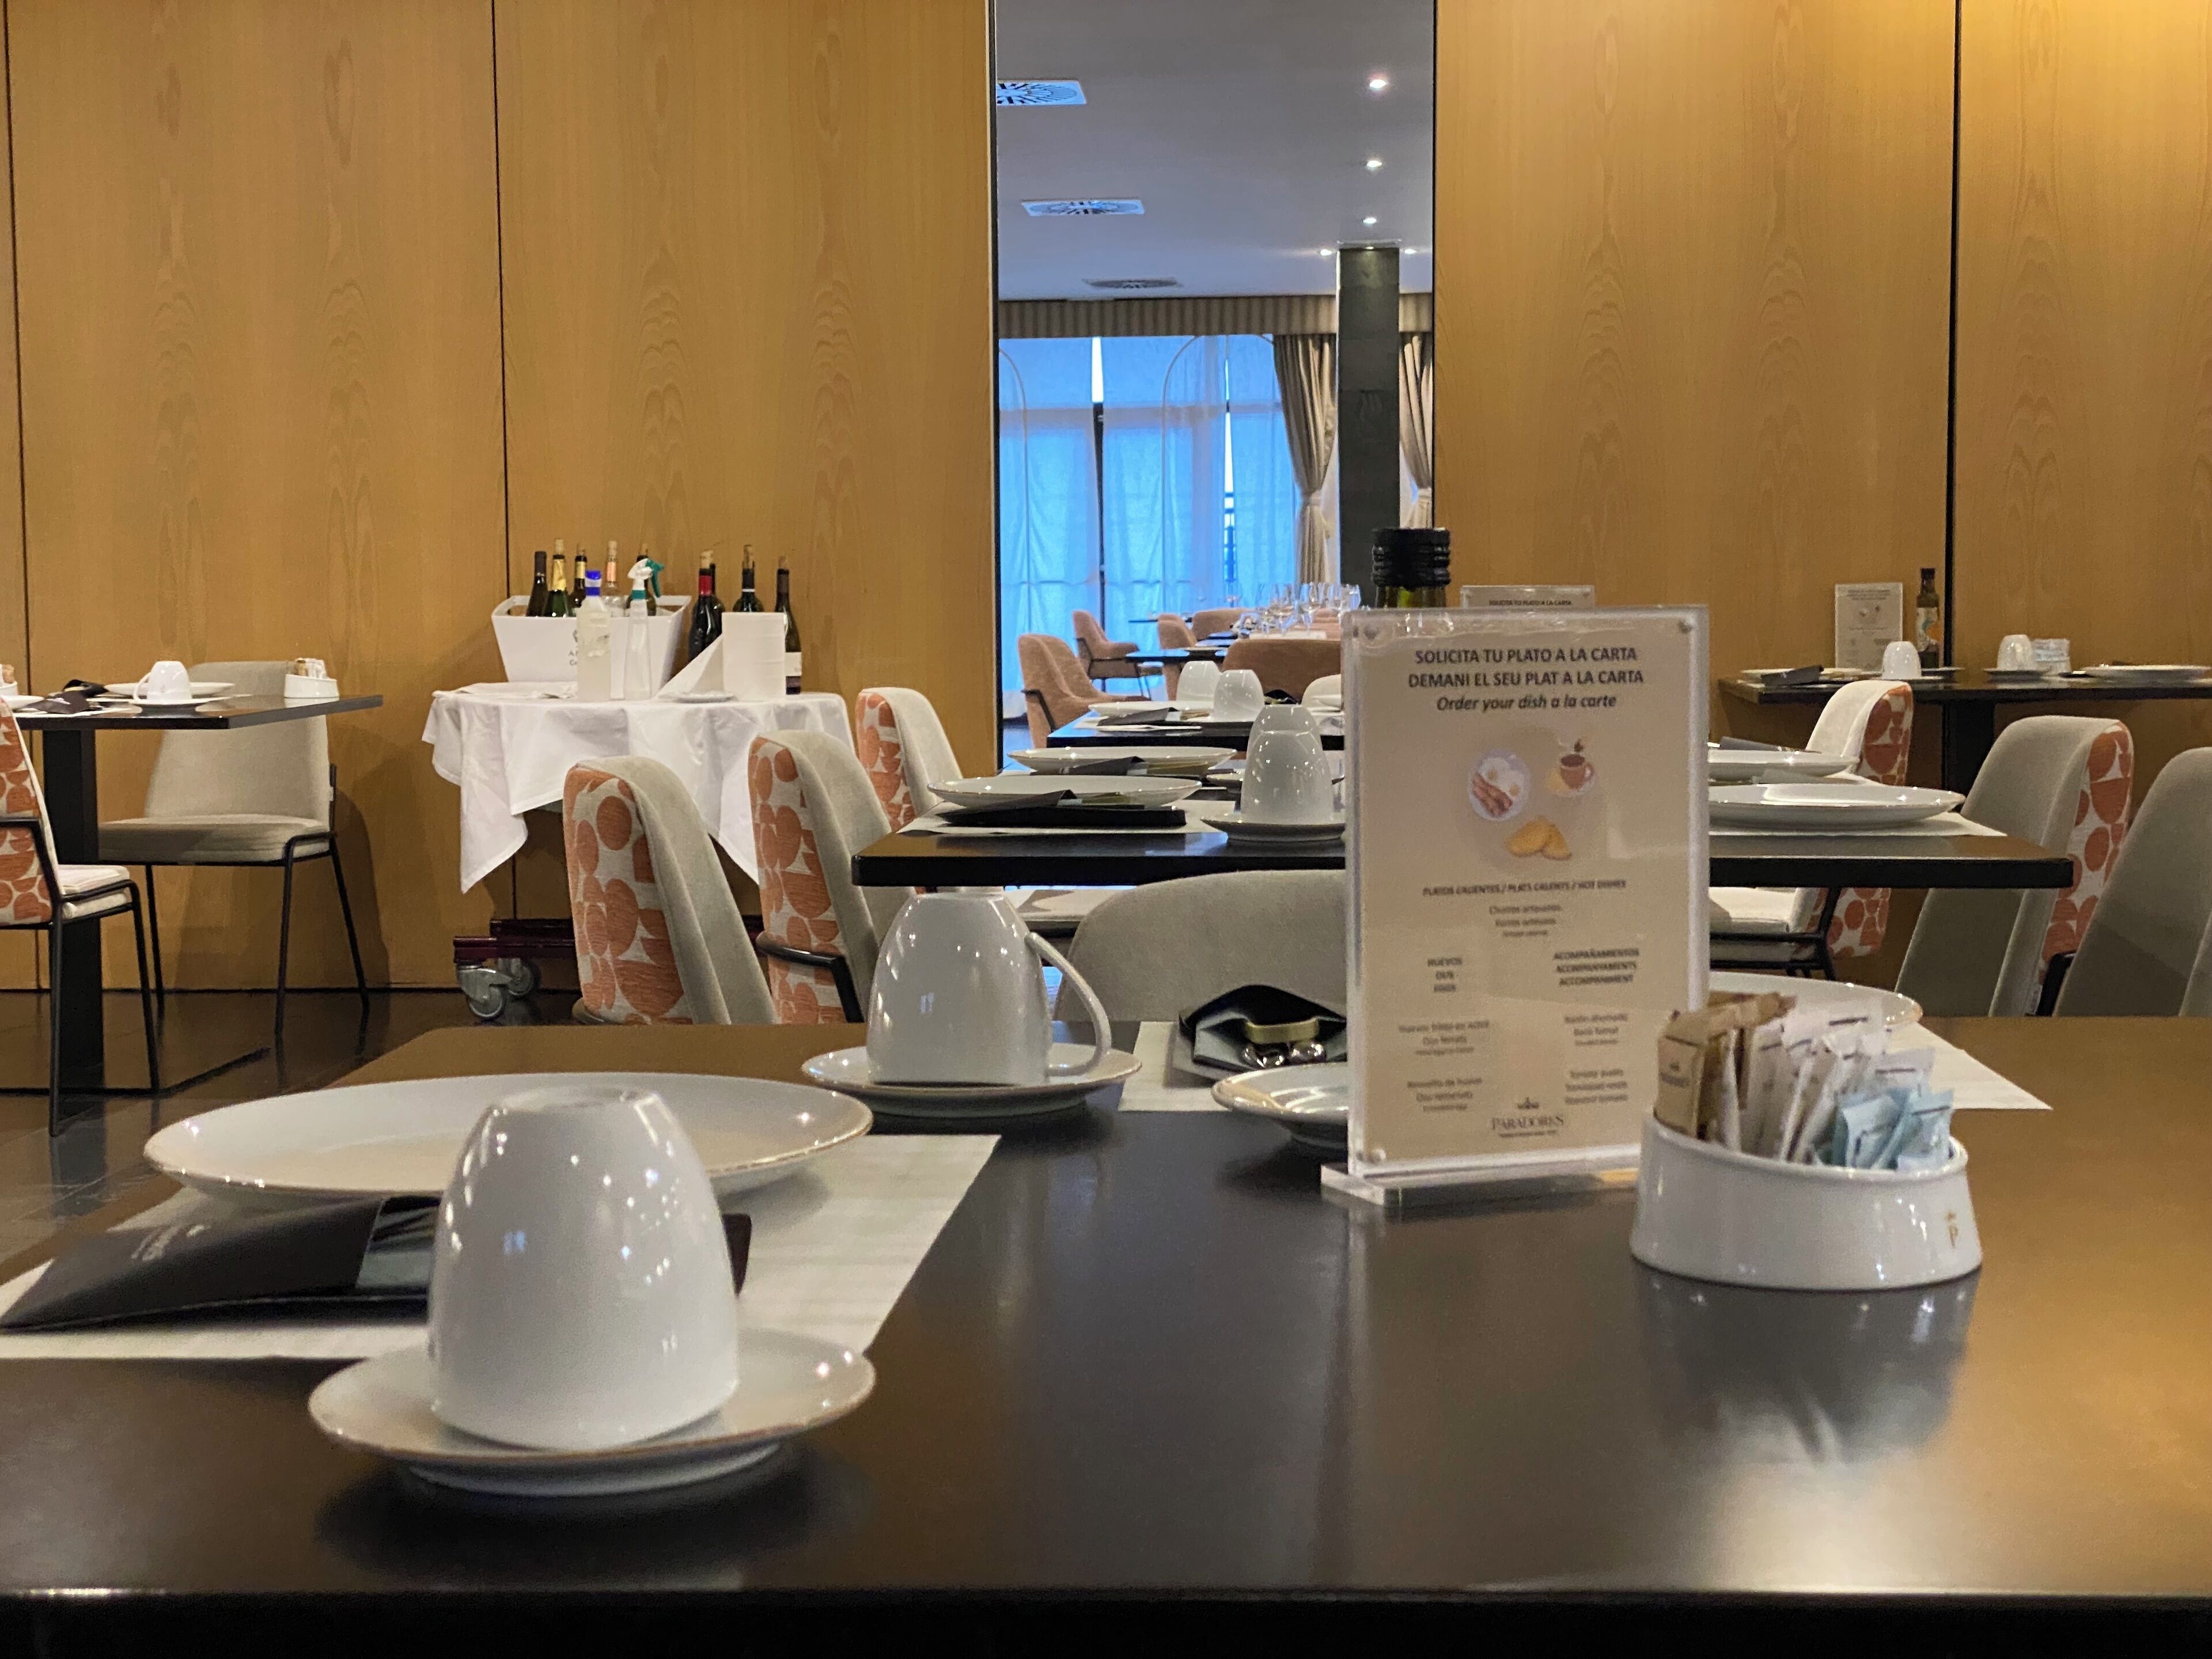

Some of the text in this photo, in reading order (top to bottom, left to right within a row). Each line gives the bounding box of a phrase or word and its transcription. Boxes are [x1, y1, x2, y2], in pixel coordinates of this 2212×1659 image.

[1415, 647, 1637, 664] SOLICITA TU PLATO A LA CARTA
[1408, 670, 1643, 687] DEMANI EL SEU PLAT A LA CARTA
[1436, 694, 1617, 713] Order your dish a la carte
